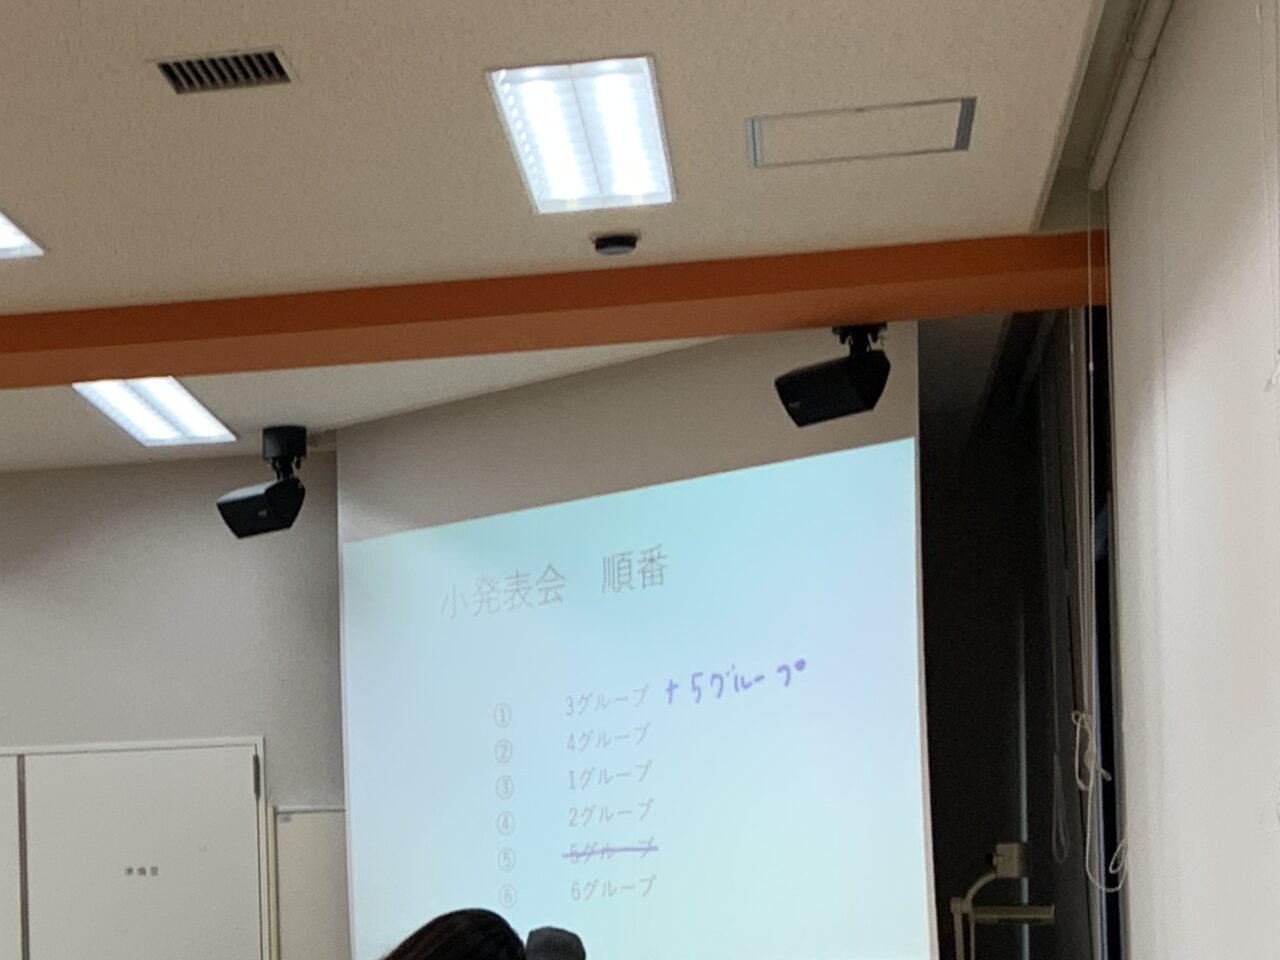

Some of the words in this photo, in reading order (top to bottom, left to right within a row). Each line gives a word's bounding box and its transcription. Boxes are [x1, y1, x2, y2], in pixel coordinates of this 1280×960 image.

[439, 562, 568, 620] 小発表会
[600, 543, 669, 594] 順番
[564, 683, 650, 718] 3グループ
[566, 721, 651, 753] 4グループ
[568, 759, 653, 791] 1グループ
[569, 797, 654, 828] 2グループ
[571, 873, 657, 902] 6グループ
